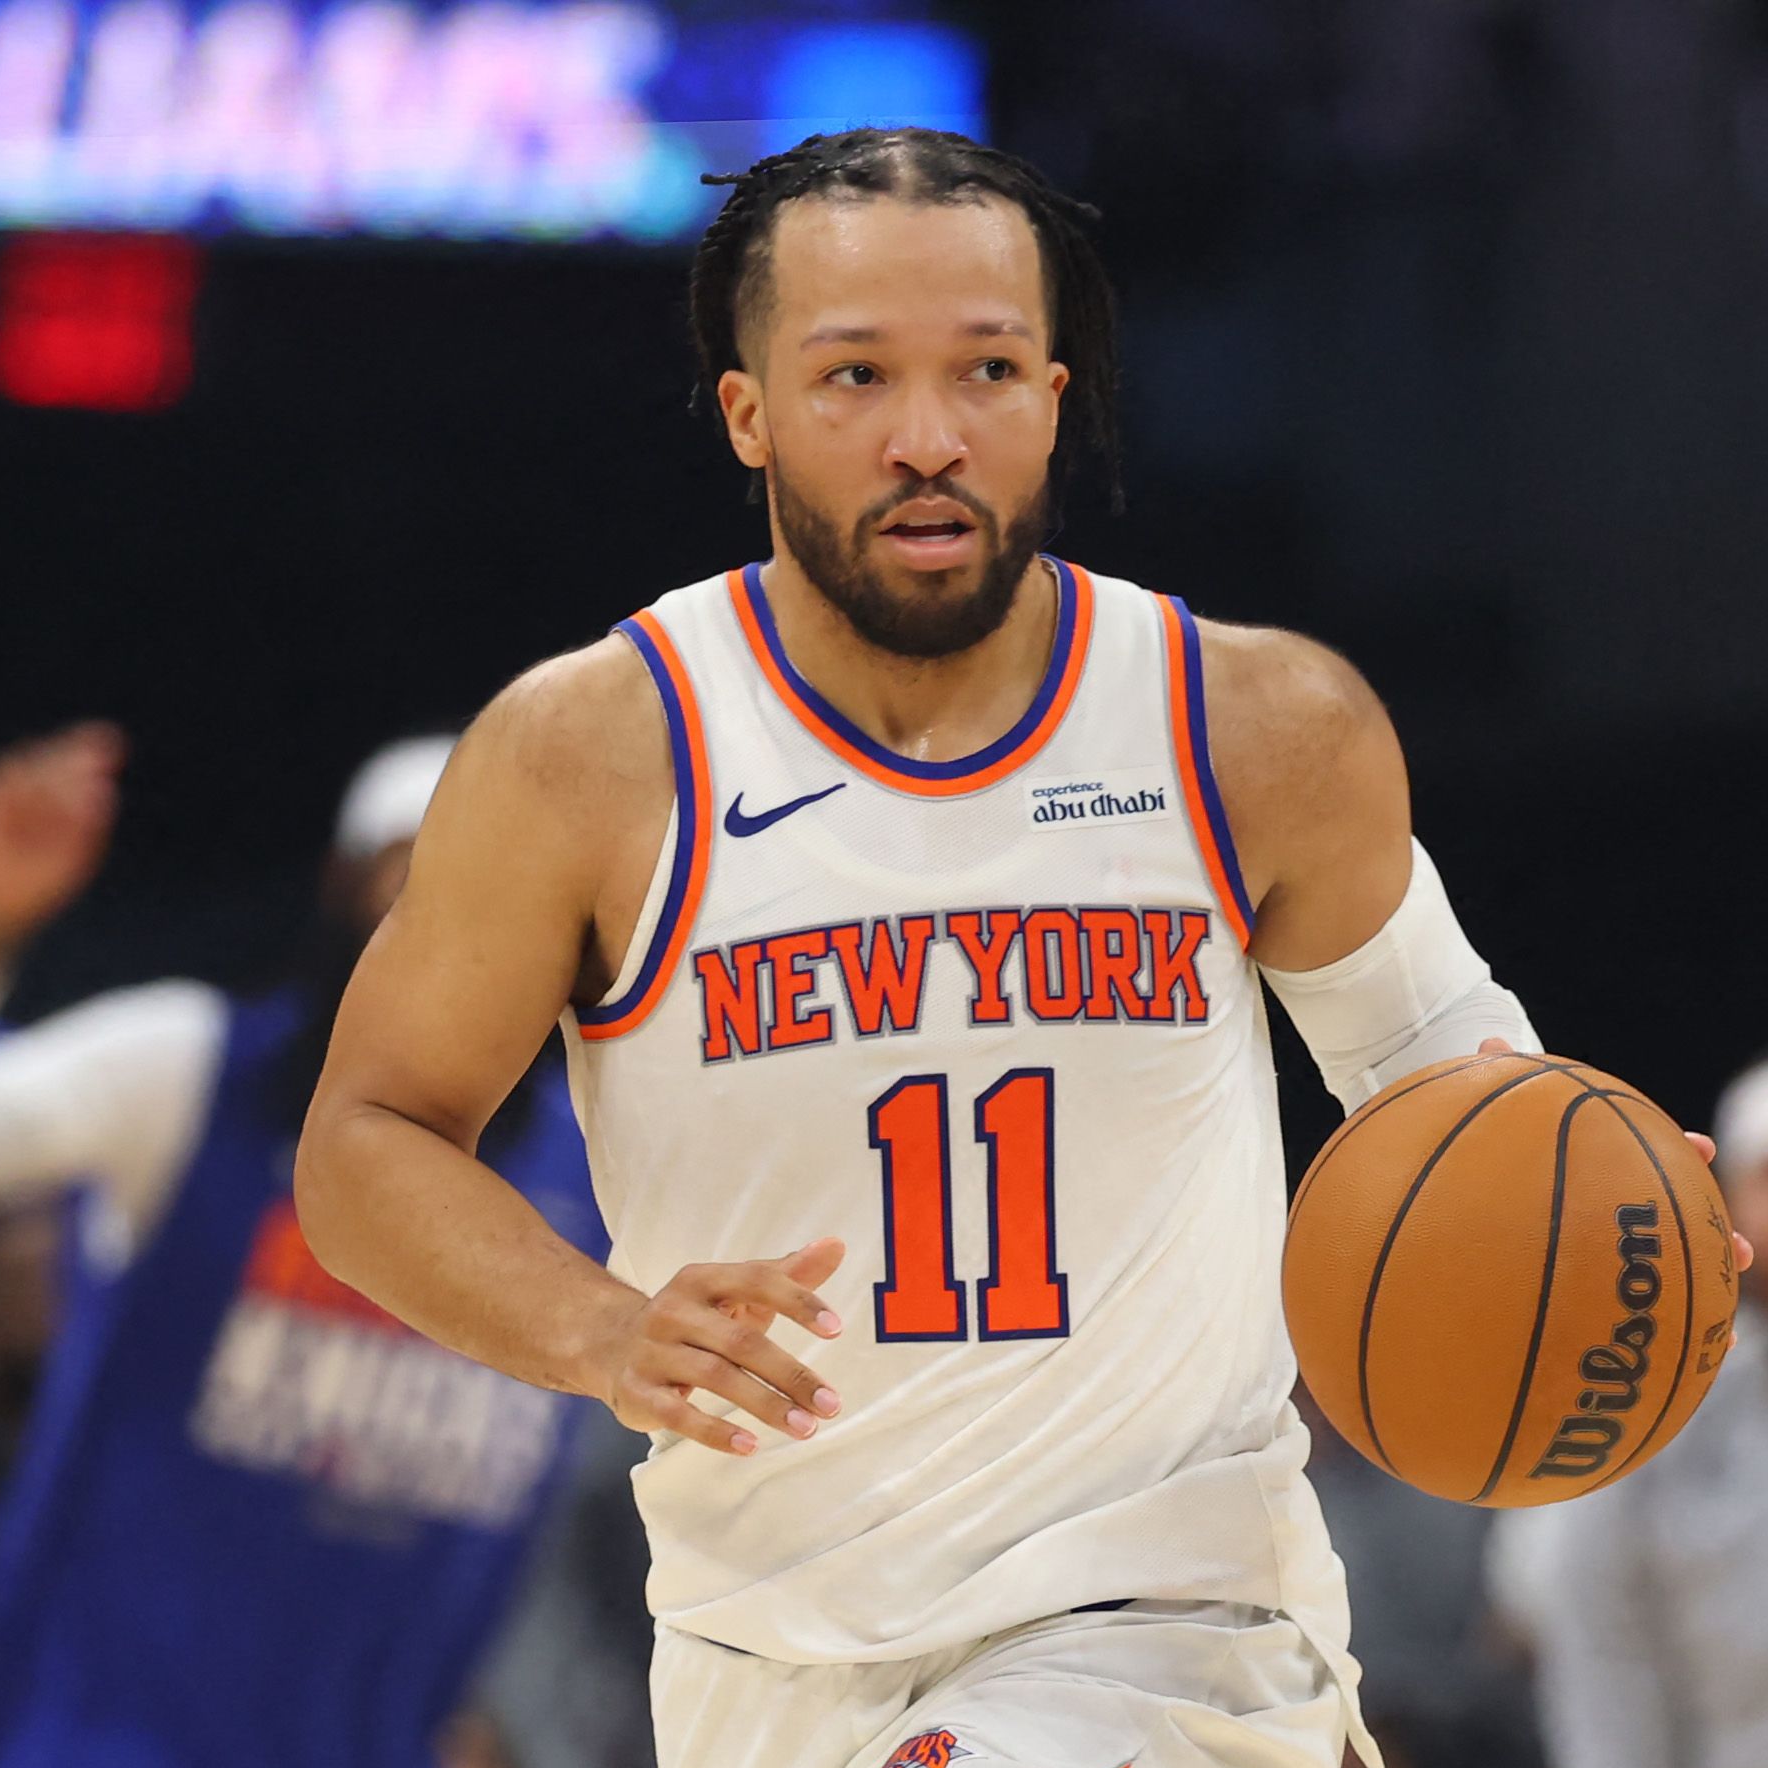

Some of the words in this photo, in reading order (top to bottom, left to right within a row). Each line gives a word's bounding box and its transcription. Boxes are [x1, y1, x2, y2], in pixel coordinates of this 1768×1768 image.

[1032, 782, 1104, 799] experience
[1033, 799, 1086, 823] abu
[1090, 787, 1167, 816] dhabi
[691, 914, 935, 1065] NEW
[943, 904, 1211, 1027] YORK
[867, 1067, 1070, 1343] 11
[1526, 1200, 1662, 1480] Wilson
